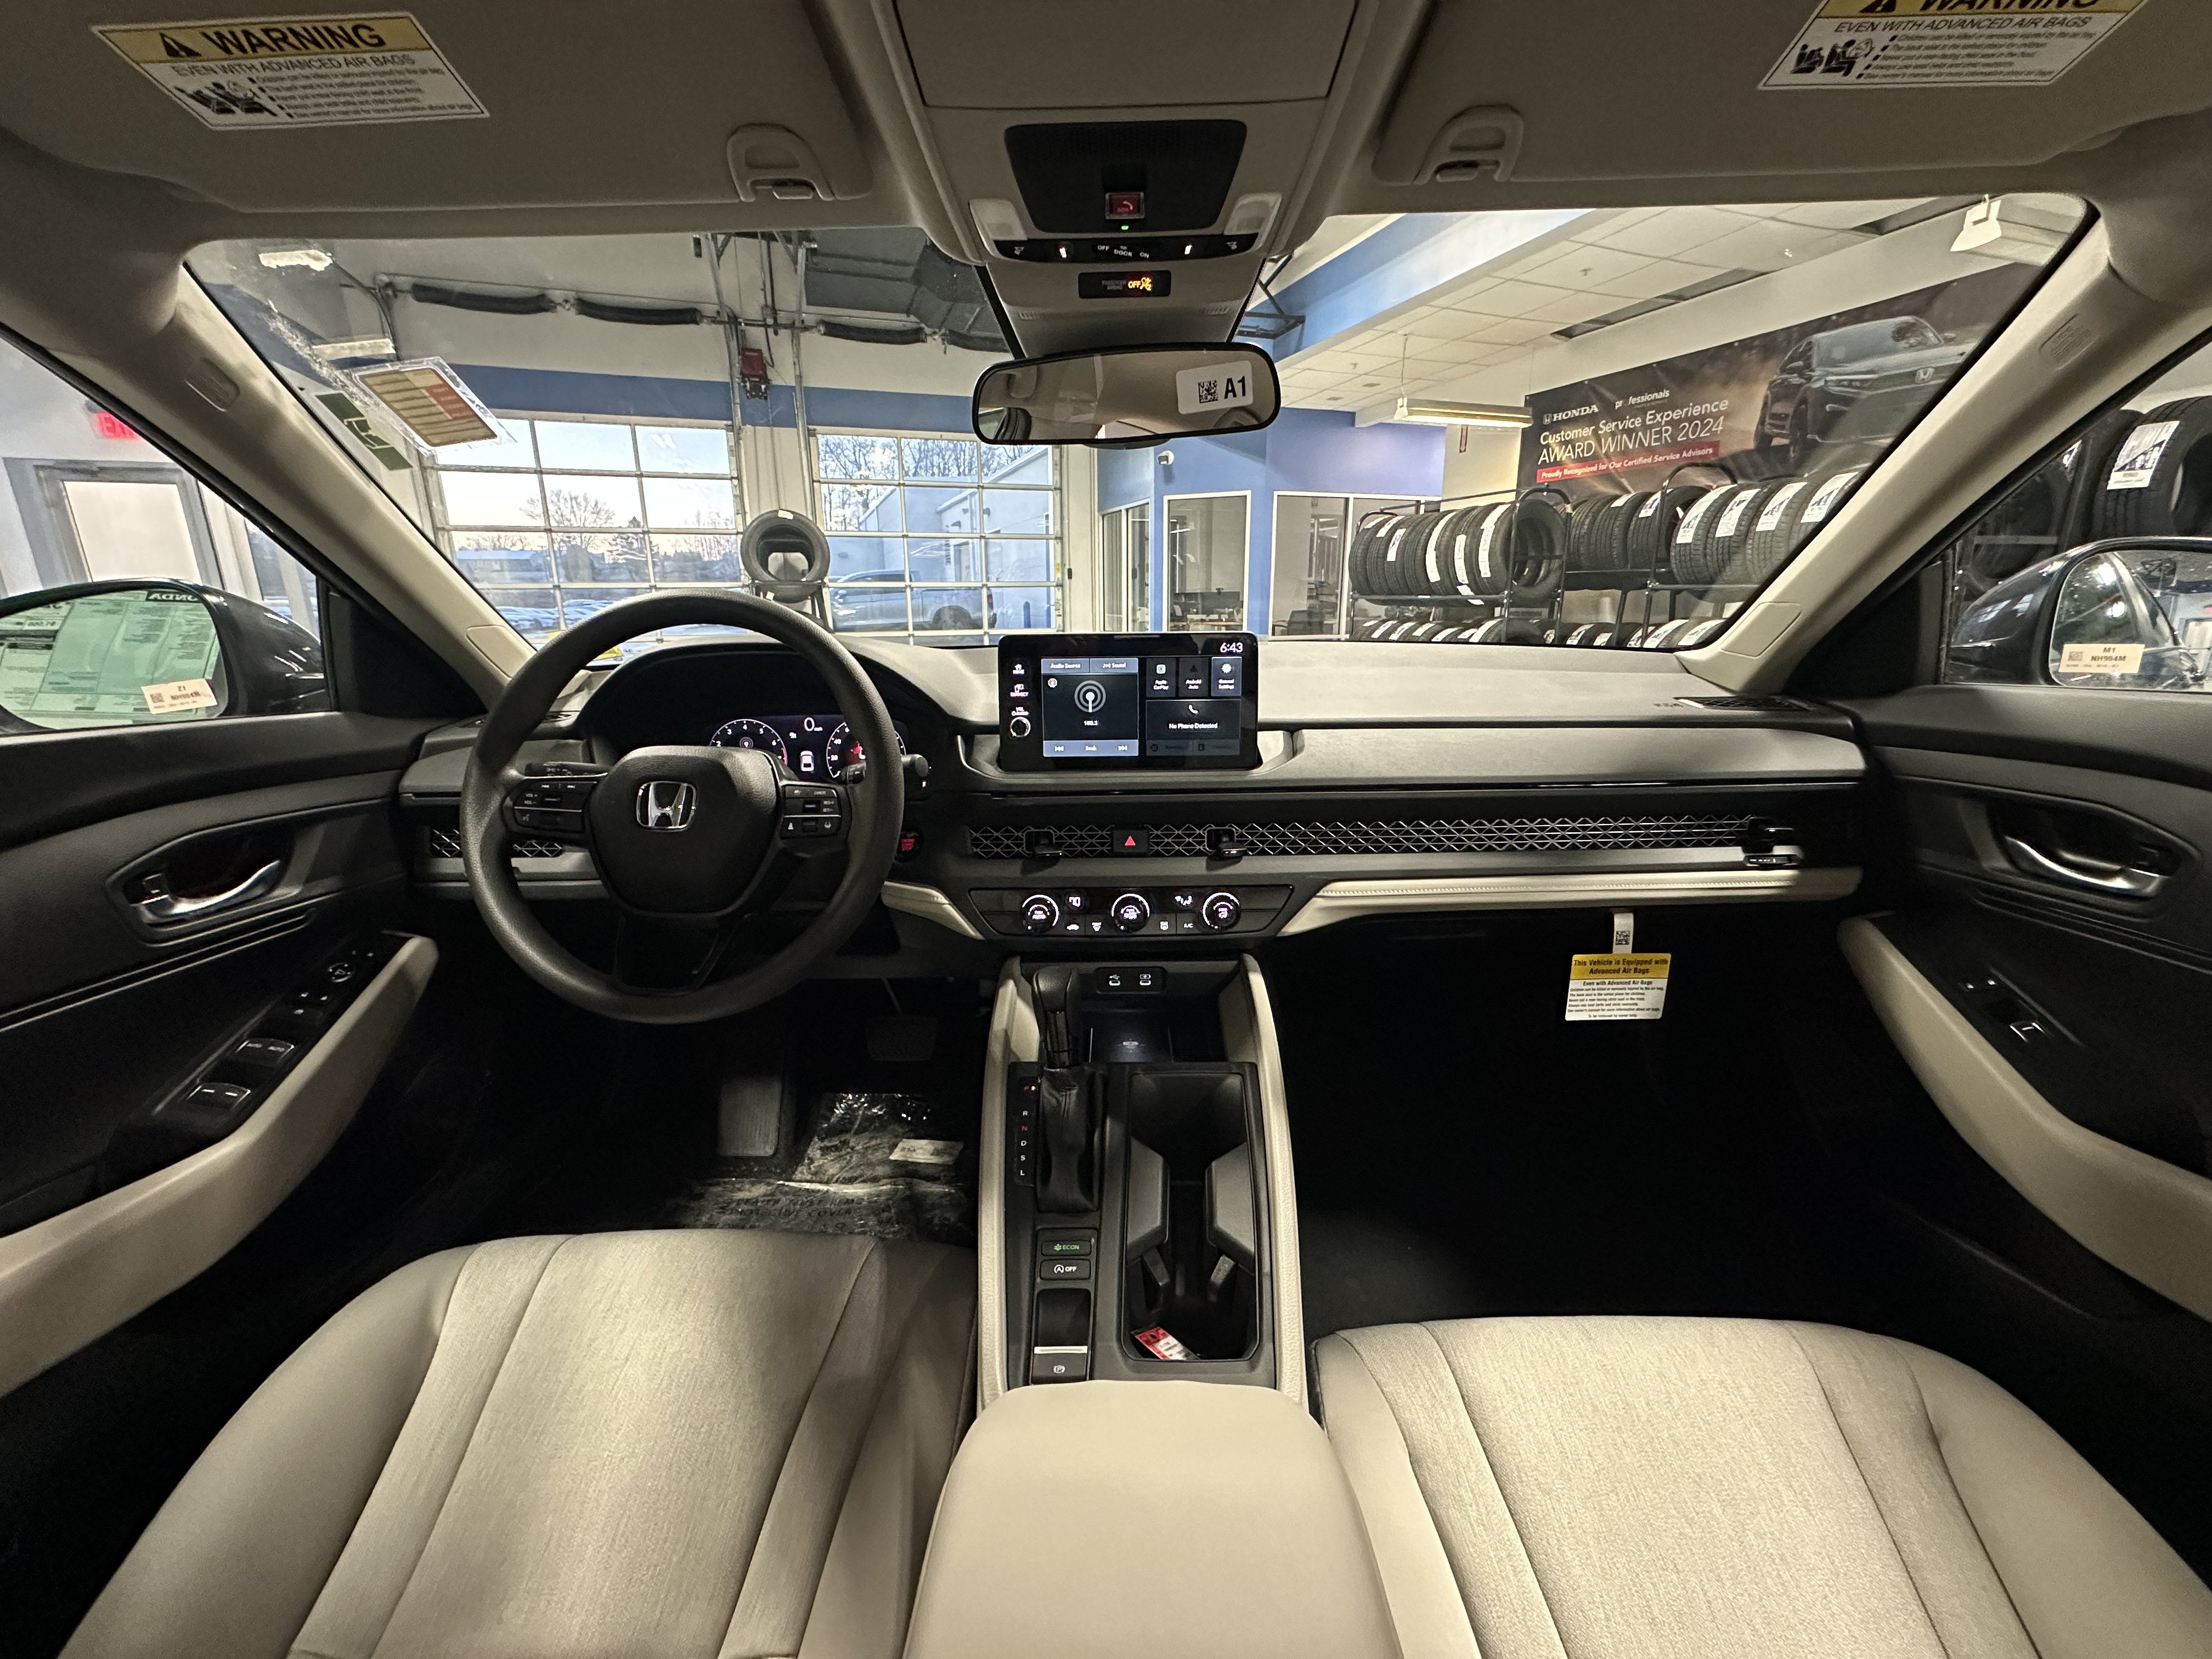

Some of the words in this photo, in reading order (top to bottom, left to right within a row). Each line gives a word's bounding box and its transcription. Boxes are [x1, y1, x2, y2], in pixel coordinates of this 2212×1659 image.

[1835, 21, 1878, 33] EVEN
[1882, 20, 1925, 32] WITH
[1925, 18, 2013, 31] ADVANCED
[2012, 17, 2044, 29] AIR
[2042, 16, 2094, 28] BAGS
[200, 23, 386, 55] WARNING
[172, 64, 217, 76] EVEN
[217, 62, 261, 75] WITH
[261, 58, 342, 72] ADVANCED
[343, 56, 371, 68] AIR
[370, 53, 415, 66] BAGS
[1114, 249, 1132, 257] DOOR
[1127, 280, 1141, 289] OFF
[1224, 375, 1248, 399] A1
[1540, 425, 1595, 445] Customer
[1598, 415, 1642, 434] Service
[1646, 399, 1729, 425] Experience
[1552, 404, 1599, 421] HONDA
[1538, 440, 1595, 465] AWARD
[1601, 426, 1671, 454] WINNER
[1677, 415, 1724, 441] 2024
[1541, 471, 1562, 479] Proudly
[1564, 464, 1598, 476] Recognized
[1624, 456, 1652, 467] Certified
[1654, 452, 1680, 463] Service
[1681, 447, 1713, 458] Advisors
[1220, 642, 1243, 653] 6:43
[804, 717, 814, 731] 0
